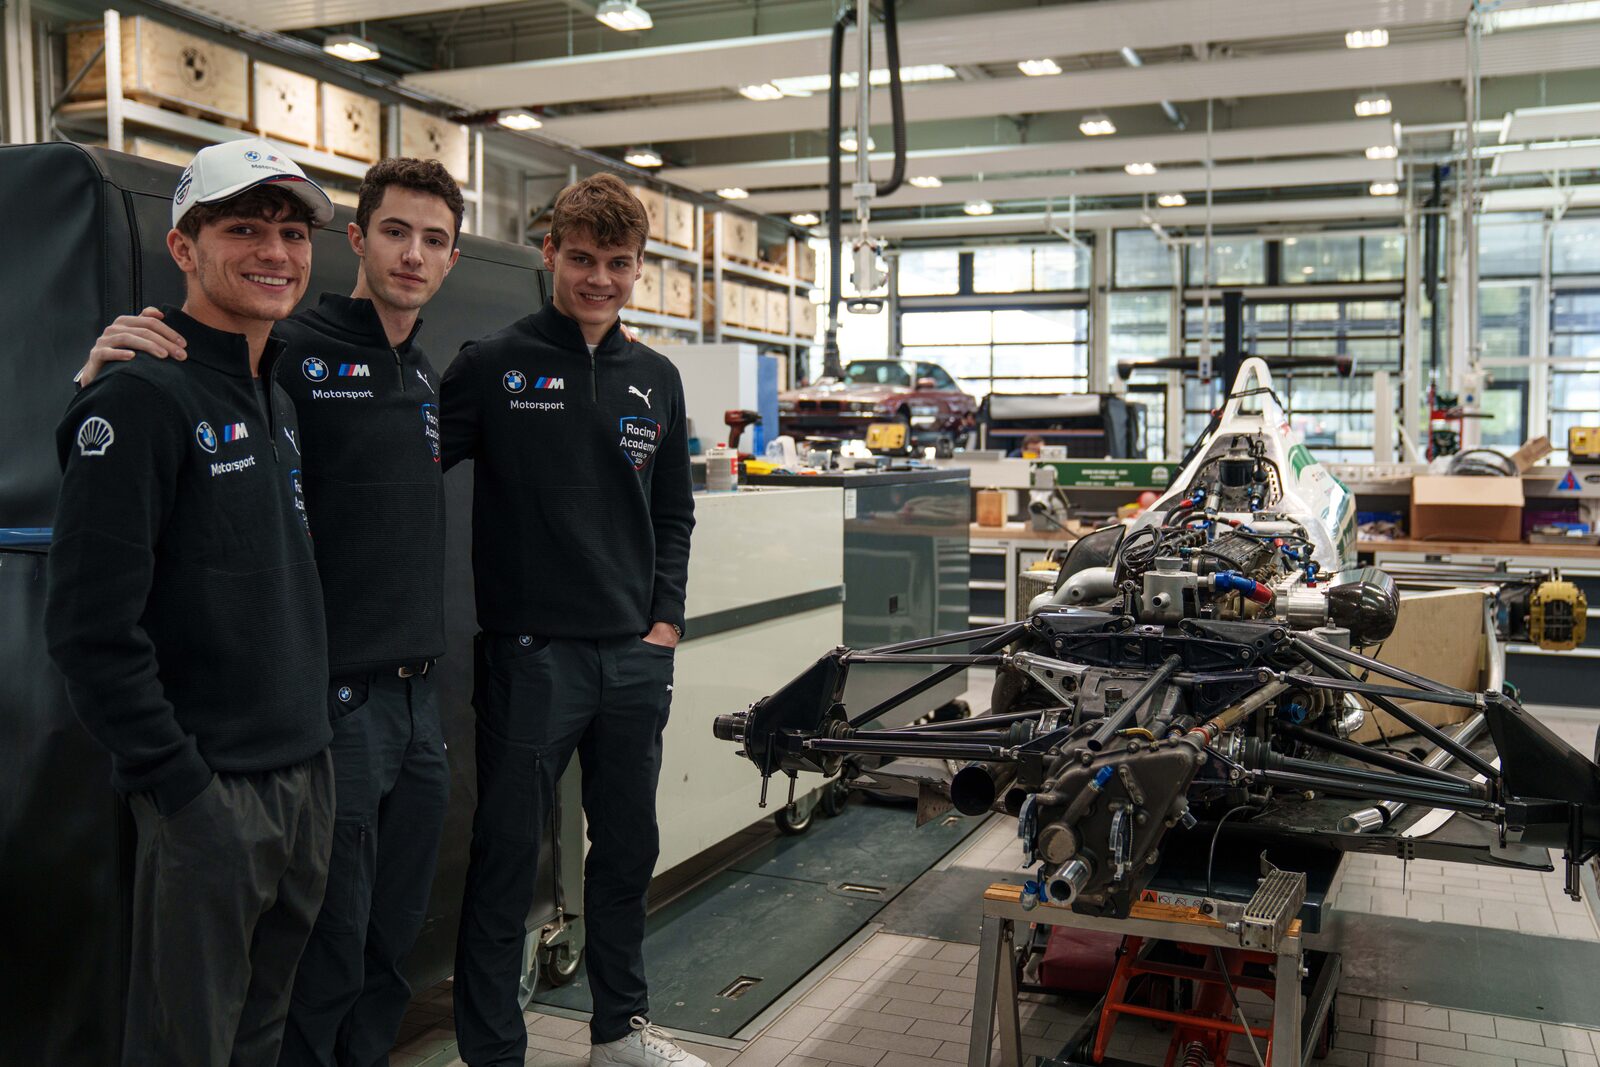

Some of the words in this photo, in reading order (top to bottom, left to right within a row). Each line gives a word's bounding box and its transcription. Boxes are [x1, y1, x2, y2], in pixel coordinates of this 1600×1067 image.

[312, 389, 374, 400] Motorsport
[510, 399, 565, 412] Motorsport
[626, 423, 656, 441] Racing
[619, 436, 657, 454] Academy
[210, 455, 256, 477] Motorsport
